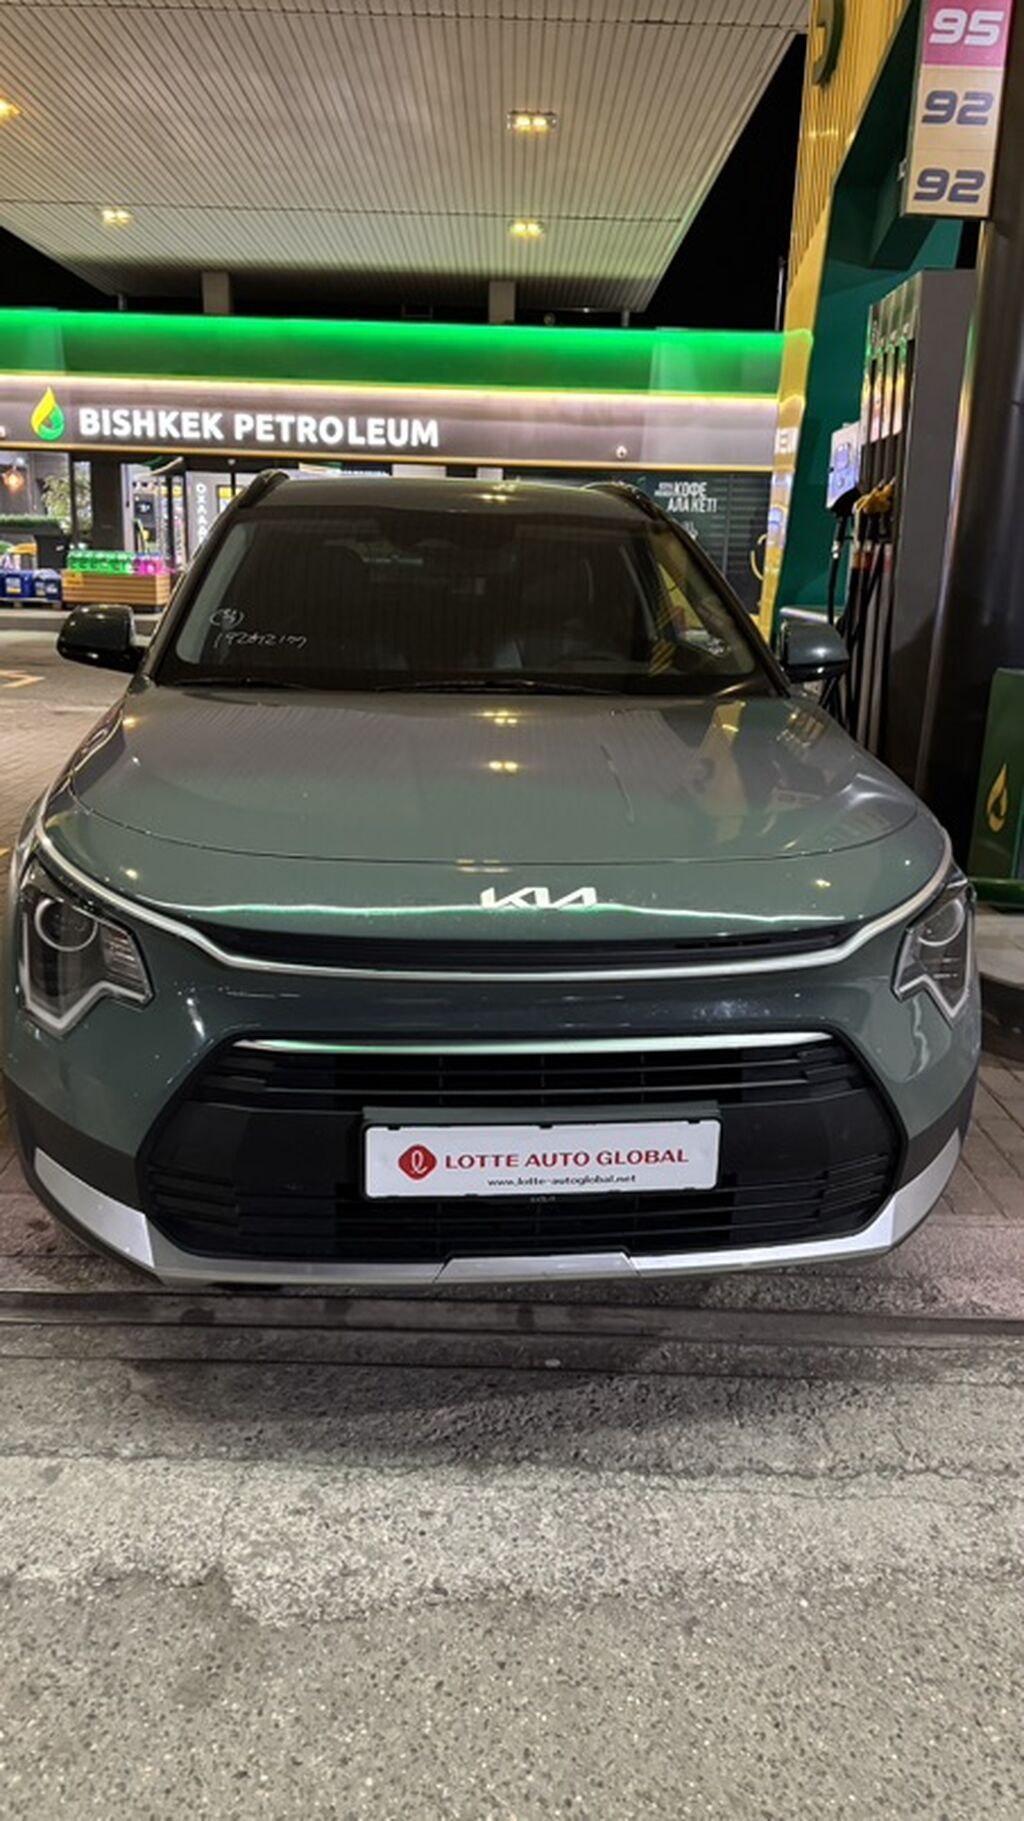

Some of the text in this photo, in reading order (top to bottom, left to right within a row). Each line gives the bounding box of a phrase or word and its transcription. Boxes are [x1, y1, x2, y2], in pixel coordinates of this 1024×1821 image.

[928, 8, 1004, 47] 95
[921, 90, 994, 126] 92
[913, 167, 986, 204] 92
[78, 407, 440, 448] BISHKEK PETROLEUM
[480, 886, 597, 909] KIA
[445, 1148, 689, 1169] LOTTE AUTO GLOBAL
[487, 1174, 637, 1187] www.lotte-autoglobal.net
